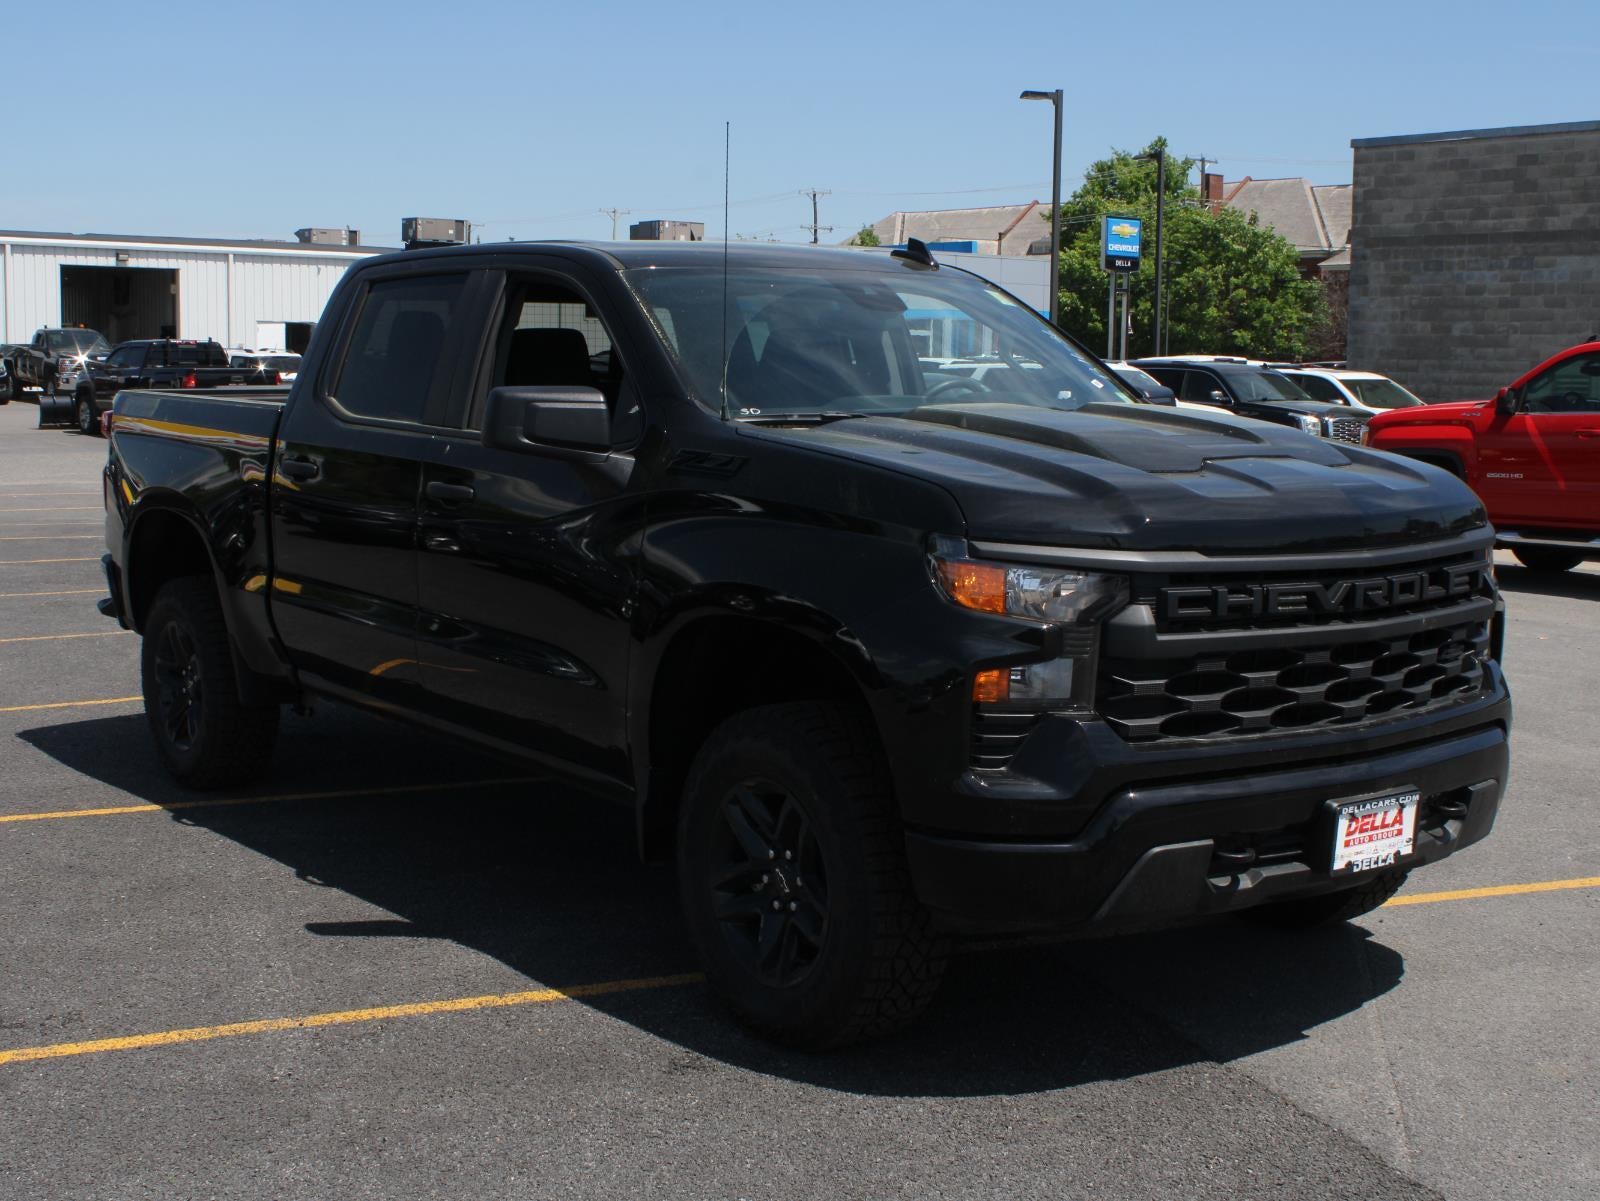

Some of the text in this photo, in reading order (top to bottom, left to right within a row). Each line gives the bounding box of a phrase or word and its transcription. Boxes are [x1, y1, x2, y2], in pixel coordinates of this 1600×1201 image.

[1108, 243, 1139, 253] CHEVROLET
[1115, 259, 1131, 267] DELLA
[1342, 794, 1420, 815] DELLACARS.COM
[1345, 806, 1404, 838] DELLA
[1349, 830, 1399, 847] AUTO GROUP
[1353, 852, 1395, 873] DELLA
